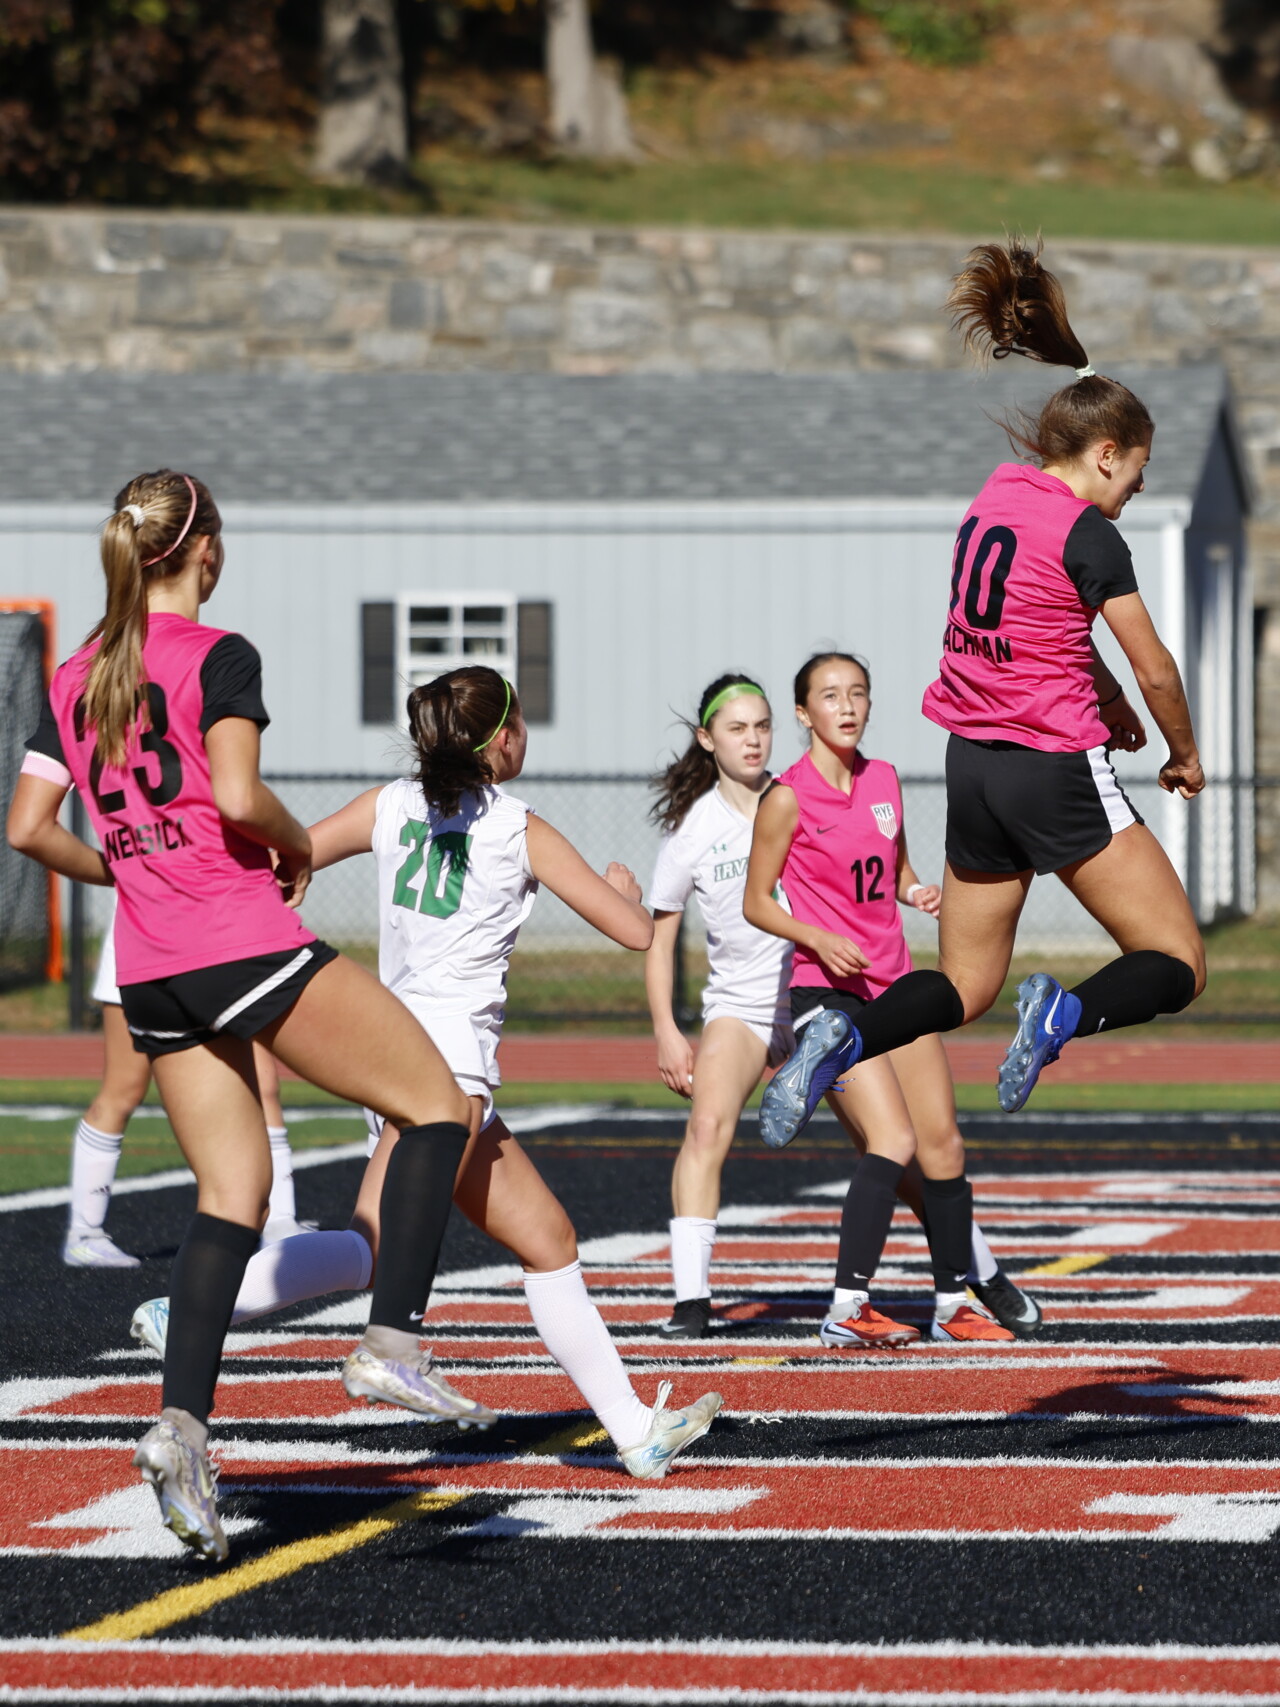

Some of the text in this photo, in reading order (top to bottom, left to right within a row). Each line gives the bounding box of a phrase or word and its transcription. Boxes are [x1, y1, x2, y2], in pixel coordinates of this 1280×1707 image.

[949, 515, 1017, 631] 10
[73, 682, 183, 815] 23
[873, 804, 894, 819] RYE
[392, 817, 475, 920] 20
[850, 855, 886, 904] 12
